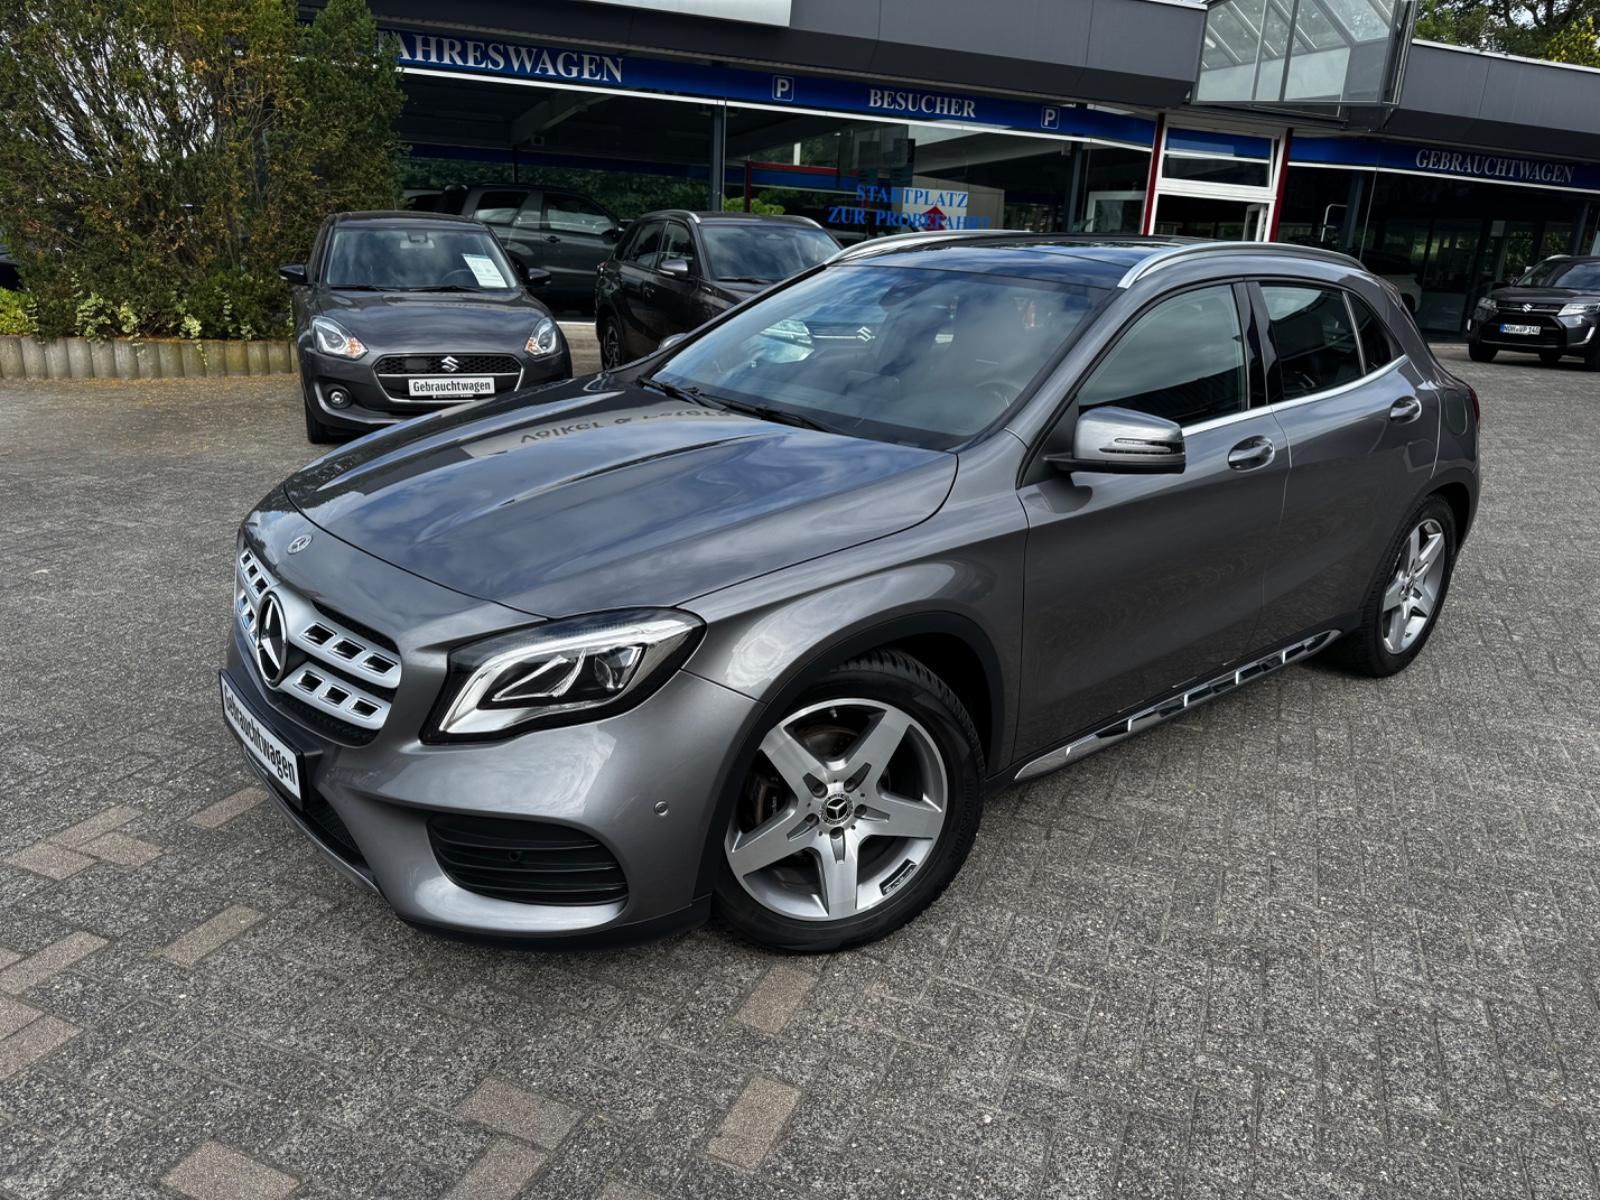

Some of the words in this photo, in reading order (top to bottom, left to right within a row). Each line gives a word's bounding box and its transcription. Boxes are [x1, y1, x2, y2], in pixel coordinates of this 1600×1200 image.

[868, 88, 976, 118] BESUCHER
[1415, 149, 1576, 183] GEBRAUCHTWAGEN
[856, 184, 969, 209] STARTPLATZ
[827, 206, 866, 225] ZUR
[876, 210, 991, 230] PROBEFAHRT
[413, 380, 491, 393] Gebrauchtwagen
[224, 684, 297, 786] Gebrauchtwagen
